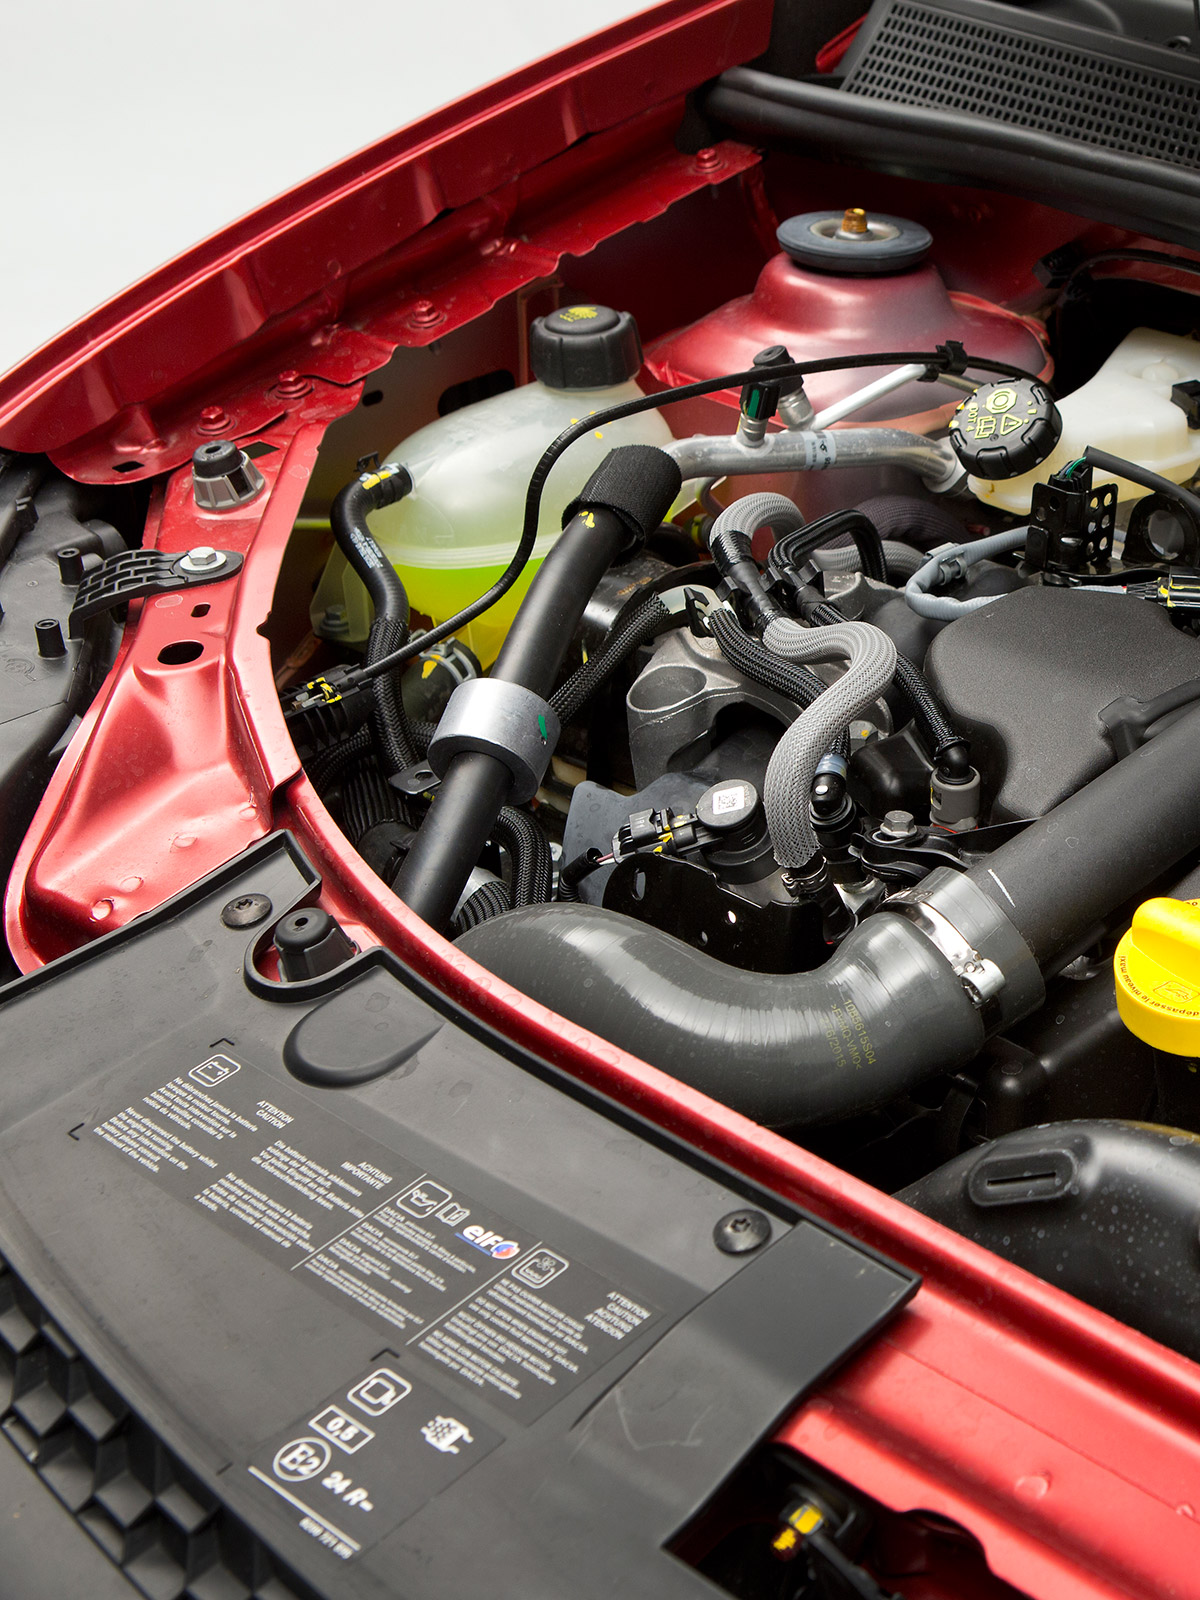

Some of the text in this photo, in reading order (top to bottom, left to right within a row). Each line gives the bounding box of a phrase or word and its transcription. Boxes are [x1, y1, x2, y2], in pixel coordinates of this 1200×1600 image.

[967, 404, 980, 425] DOT
[1118, 955, 1130, 974] maxi
[1122, 972, 1143, 999] niveau
[1141, 994, 1151, 1005] le
[254, 1108, 287, 1130] CAUTION
[255, 1099, 295, 1124] ATTENTION
[279, 1444, 322, 1475] E2
[322, 1470, 352, 1494] 24
